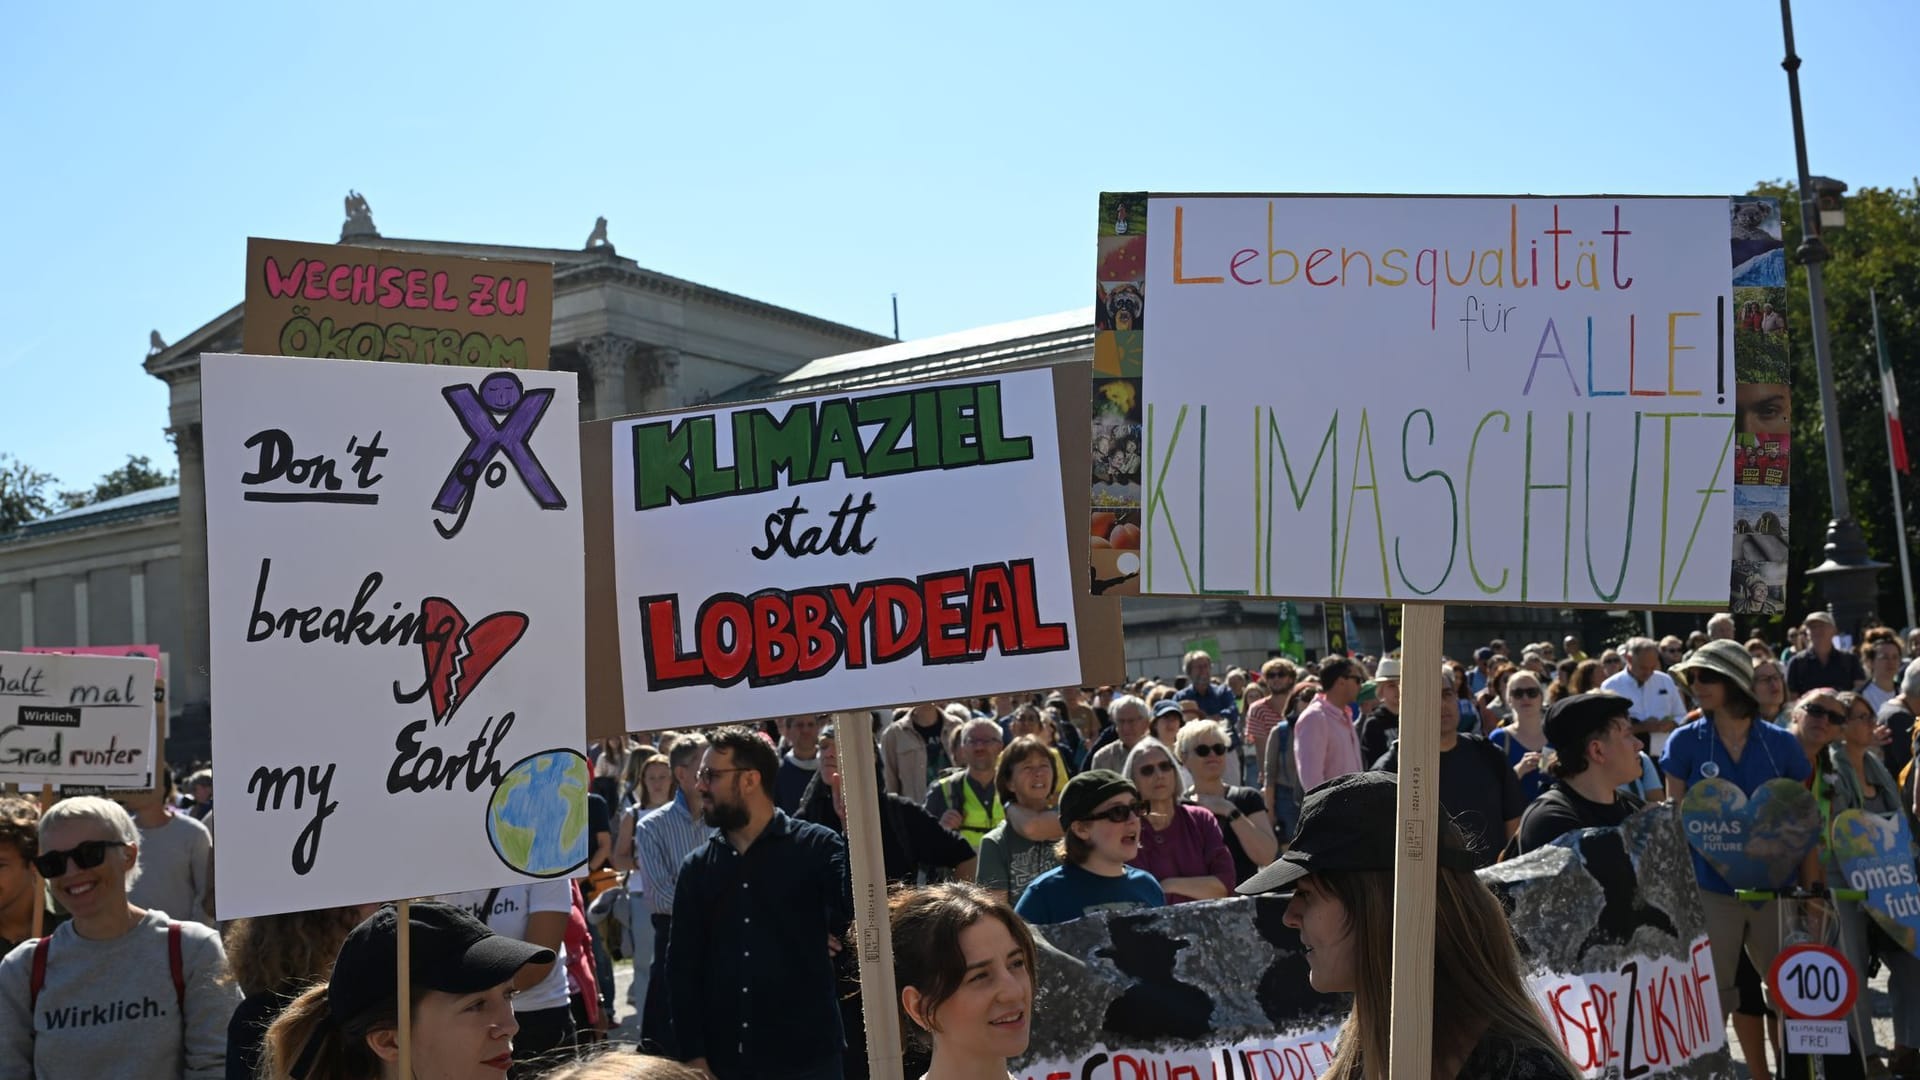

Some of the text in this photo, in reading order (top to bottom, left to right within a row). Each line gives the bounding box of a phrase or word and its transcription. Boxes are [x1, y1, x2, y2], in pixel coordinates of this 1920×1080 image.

[264, 256, 529, 316] WECHSEL ZU
[1173, 201, 1633, 330] Lebensqualität
[279, 305, 529, 369] ÖKOSTROM
[1459, 295, 1517, 372] für
[1522, 295, 1725, 405] ALLE!
[632, 381, 1034, 511] KLIMAZIEL
[241, 428, 507, 540] Don't go
[1146, 403, 1737, 605] KLIMASCHUTZ
[751, 492, 878, 560] statt
[246, 557, 457, 704] breaking
[639, 558, 1070, 692] LOBBYDEAL
[23, 710, 78, 724] Wirklich.
[69, 674, 136, 705] mal
[0, 726, 142, 767] Grad runter
[247, 711, 515, 876] my Earth
[1688, 819, 1742, 835] OMAS
[1703, 834, 1722, 842] FOR
[1703, 842, 1743, 852] FUTURE
[44, 996, 167, 1031] Wirklich.
[1786, 963, 1840, 1003] 100
[1800, 1034, 1829, 1048] FREI
